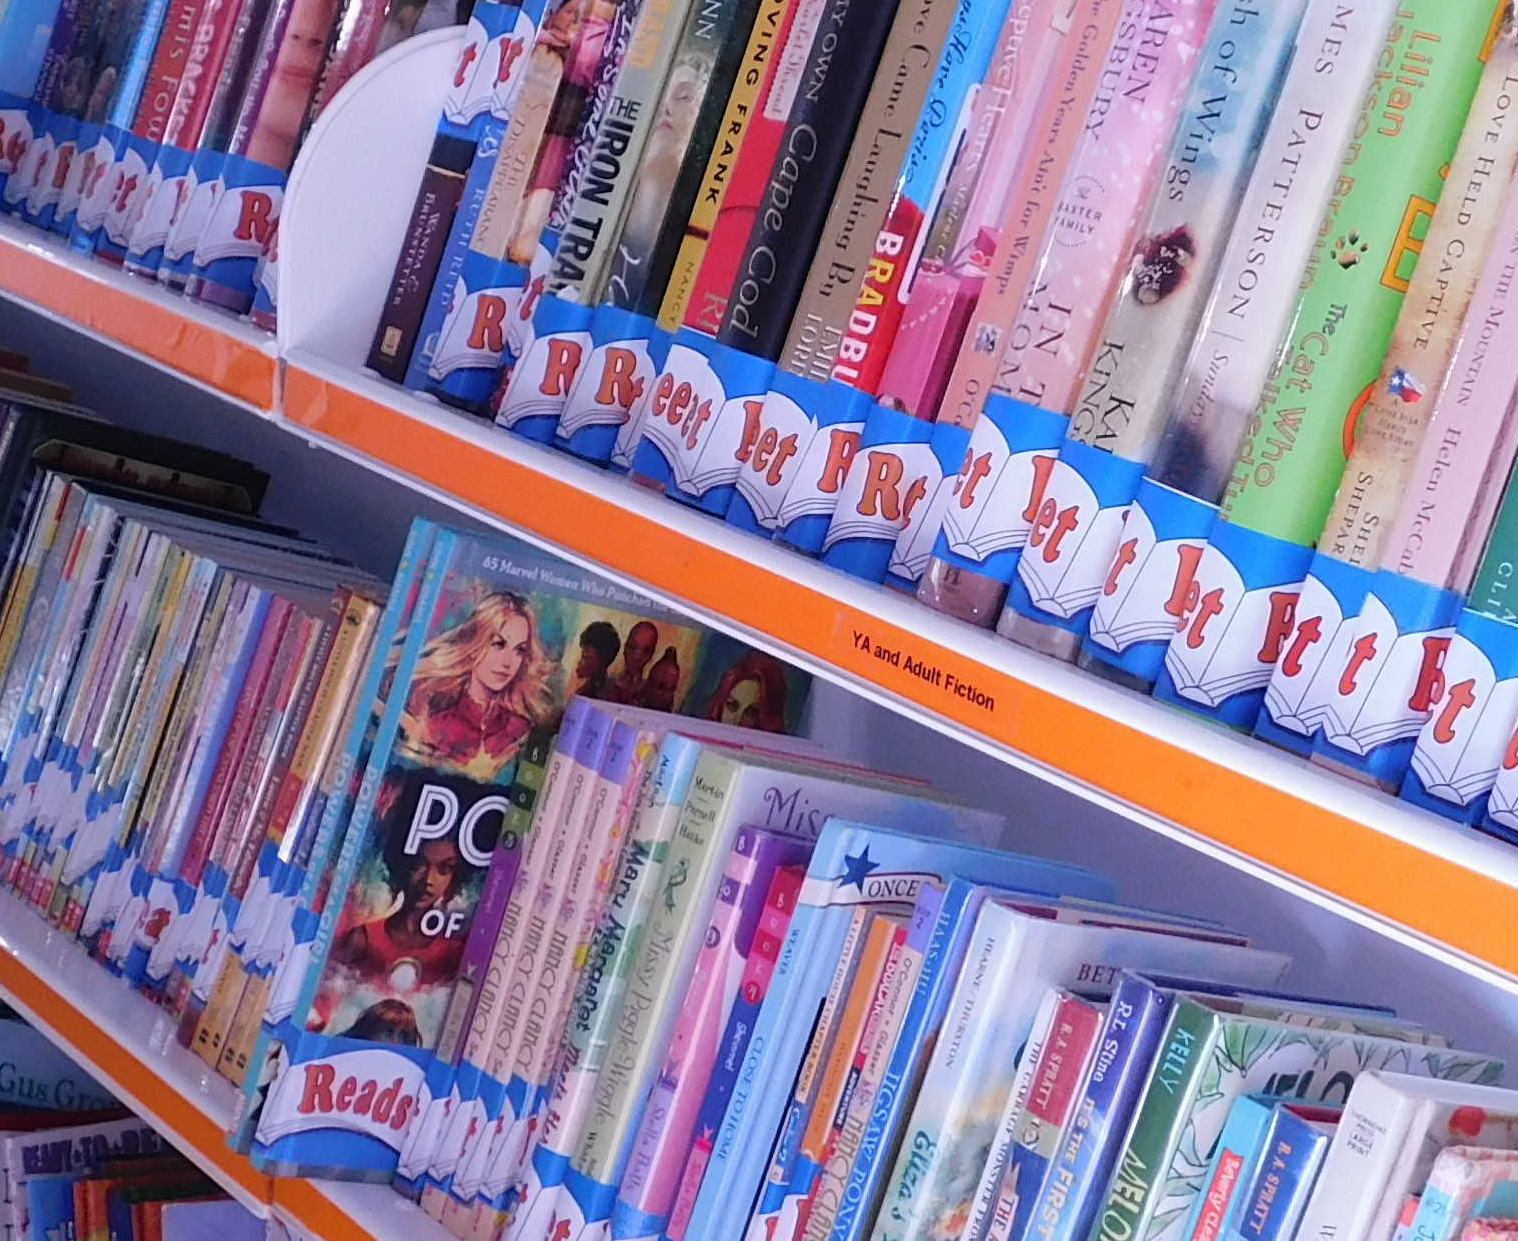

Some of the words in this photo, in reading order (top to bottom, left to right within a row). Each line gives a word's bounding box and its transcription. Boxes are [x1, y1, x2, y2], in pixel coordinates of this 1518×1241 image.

[805, 33, 838, 103] OWN
[883, 43, 932, 119] Came
[1064, 23, 1100, 93] Golden
[1217, 39, 1238, 87] of
[1377, 29, 1442, 138] Lilian
[609, 95, 642, 120] THE
[1049, 95, 1075, 149] Years
[577, 117, 636, 208] IRON
[704, 103, 748, 205] FRANK
[765, 122, 819, 234] Cape
[1166, 92, 1228, 204] Wings
[835, 126, 903, 255] Laughing
[1225, 105, 1326, 322] PATTERSON
[1455, 156, 1496, 228] HELD
[730, 244, 778, 341] Cod
[817, 260, 856, 300] By
[997, 230, 1033, 297] Wimps
[1412, 237, 1467, 352] CAPTIVE
[1493, 261, 1516, 302] THE
[1324, 302, 1349, 338] The
[1454, 302, 1507, 408] MOUNTAIN
[1285, 330, 1330, 396] Cat
[1253, 404, 1308, 488] Who
[1427, 428, 1464, 496] Helen
[482, 555, 498, 573] 65
[498, 558, 537, 584] Marvel
[538, 567, 579, 593] Women
[852, 631, 871, 654] YA
[874, 645, 902, 667] and
[902, 656, 942, 687] Adult
[944, 673, 996, 712] Fiction
[419, 908, 465, 939] OF
[867, 878, 917, 900] ONCE
[539, 930, 570, 998] NANCY
[515, 998, 550, 1075] CLANCY
[1158, 1027, 1197, 1096] KELLY
[297, 1063, 414, 1134] Reads
[859, 1071, 901, 1161] JIGSAW
[1036, 1166, 1075, 1240] FIRST
